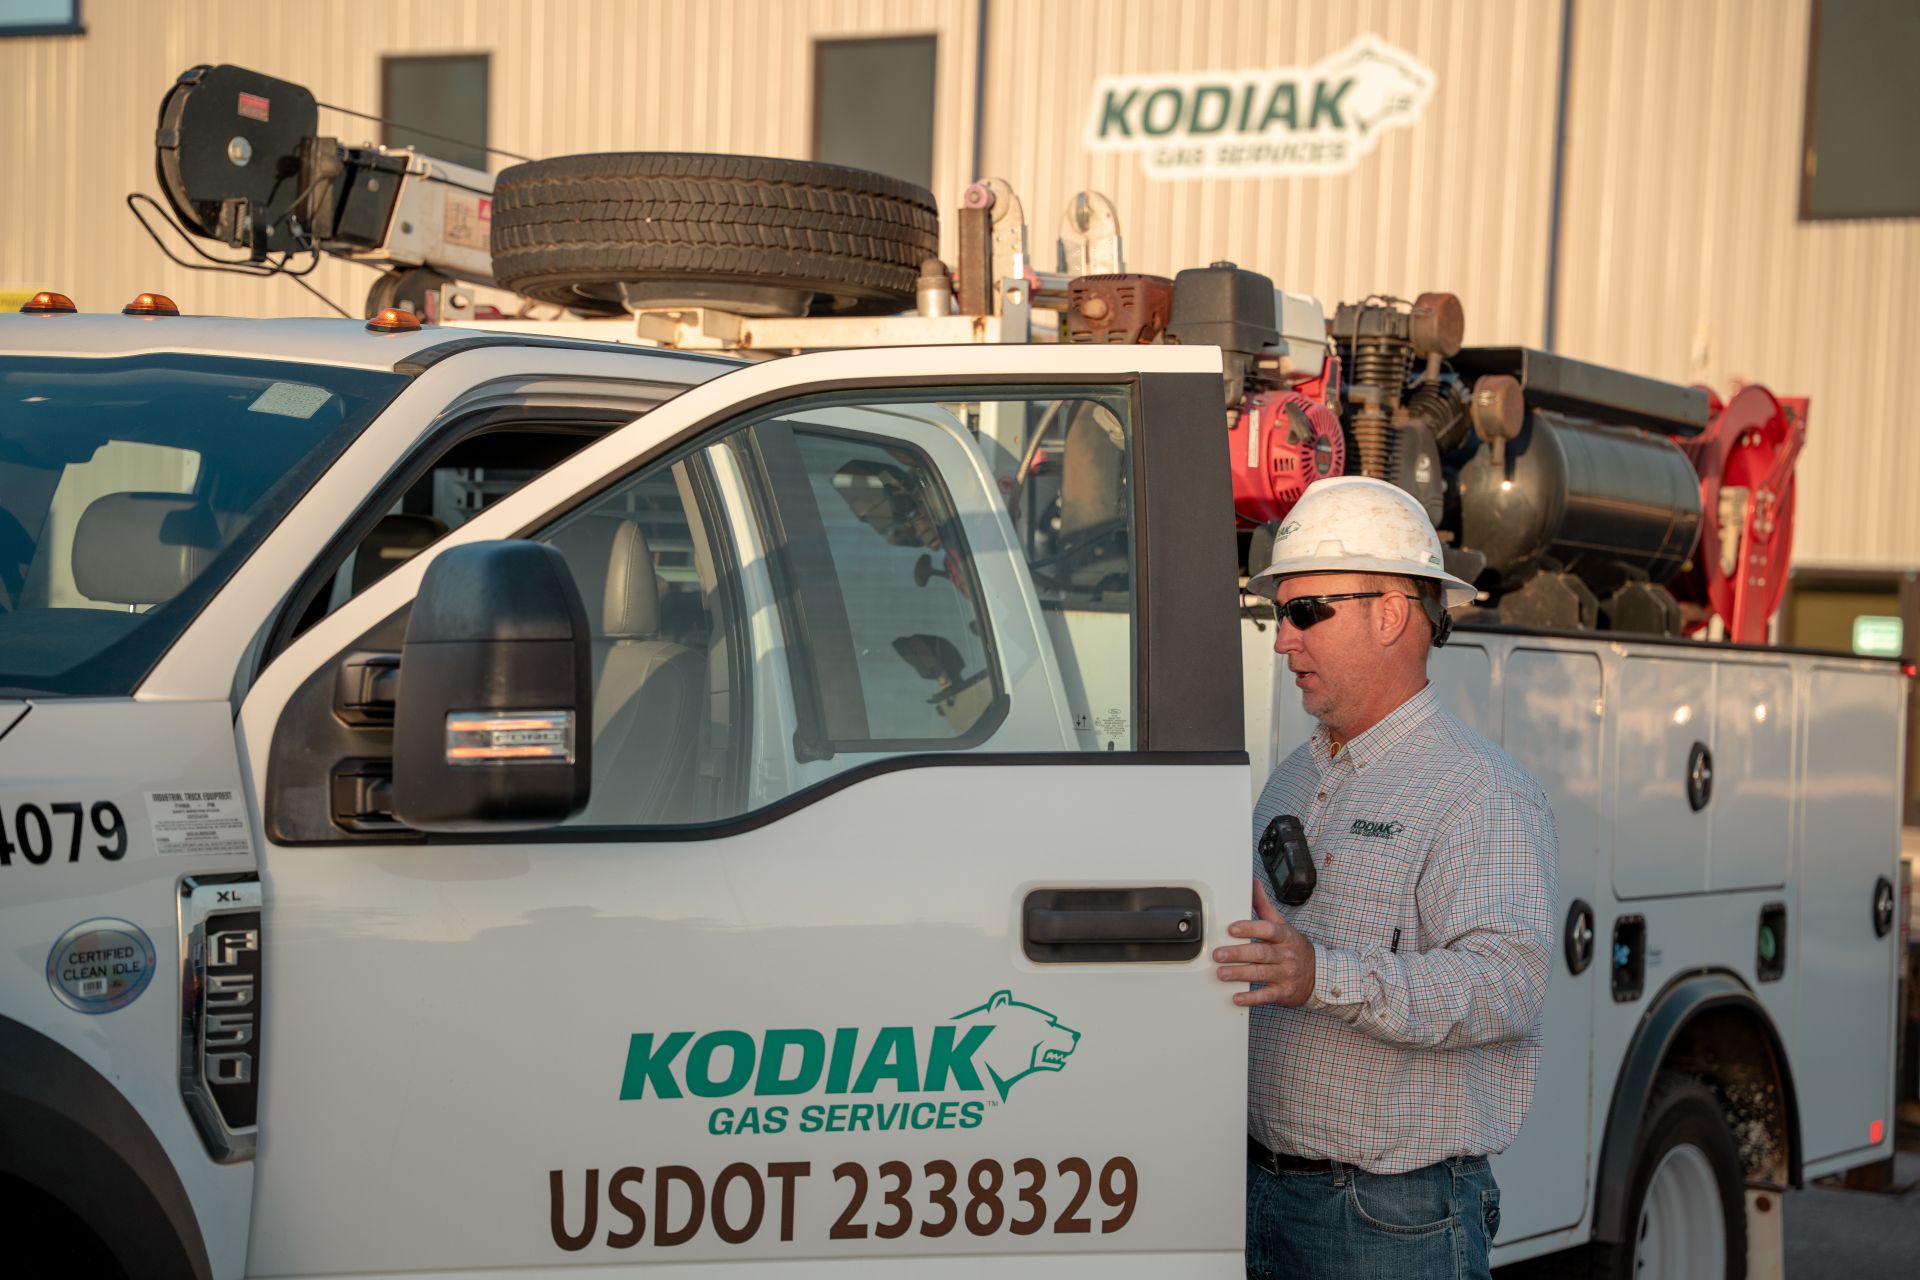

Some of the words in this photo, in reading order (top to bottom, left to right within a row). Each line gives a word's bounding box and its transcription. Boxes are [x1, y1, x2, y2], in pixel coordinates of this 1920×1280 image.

[1097, 77, 1355, 139] KODIAK
[184, 791, 202, 801] TRUCK
[216, 890, 242, 904] XL
[68, 946, 134, 965] CERTIFIED
[63, 966, 108, 982] CLEAN
[113, 961, 141, 976] IDLE
[618, 1024, 997, 1101] KODIAK
[707, 1106, 788, 1136] GAS
[799, 1101, 984, 1133] SERVICES
[549, 1161, 811, 1251] USDOT
[829, 1156, 1139, 1241] 2338329
